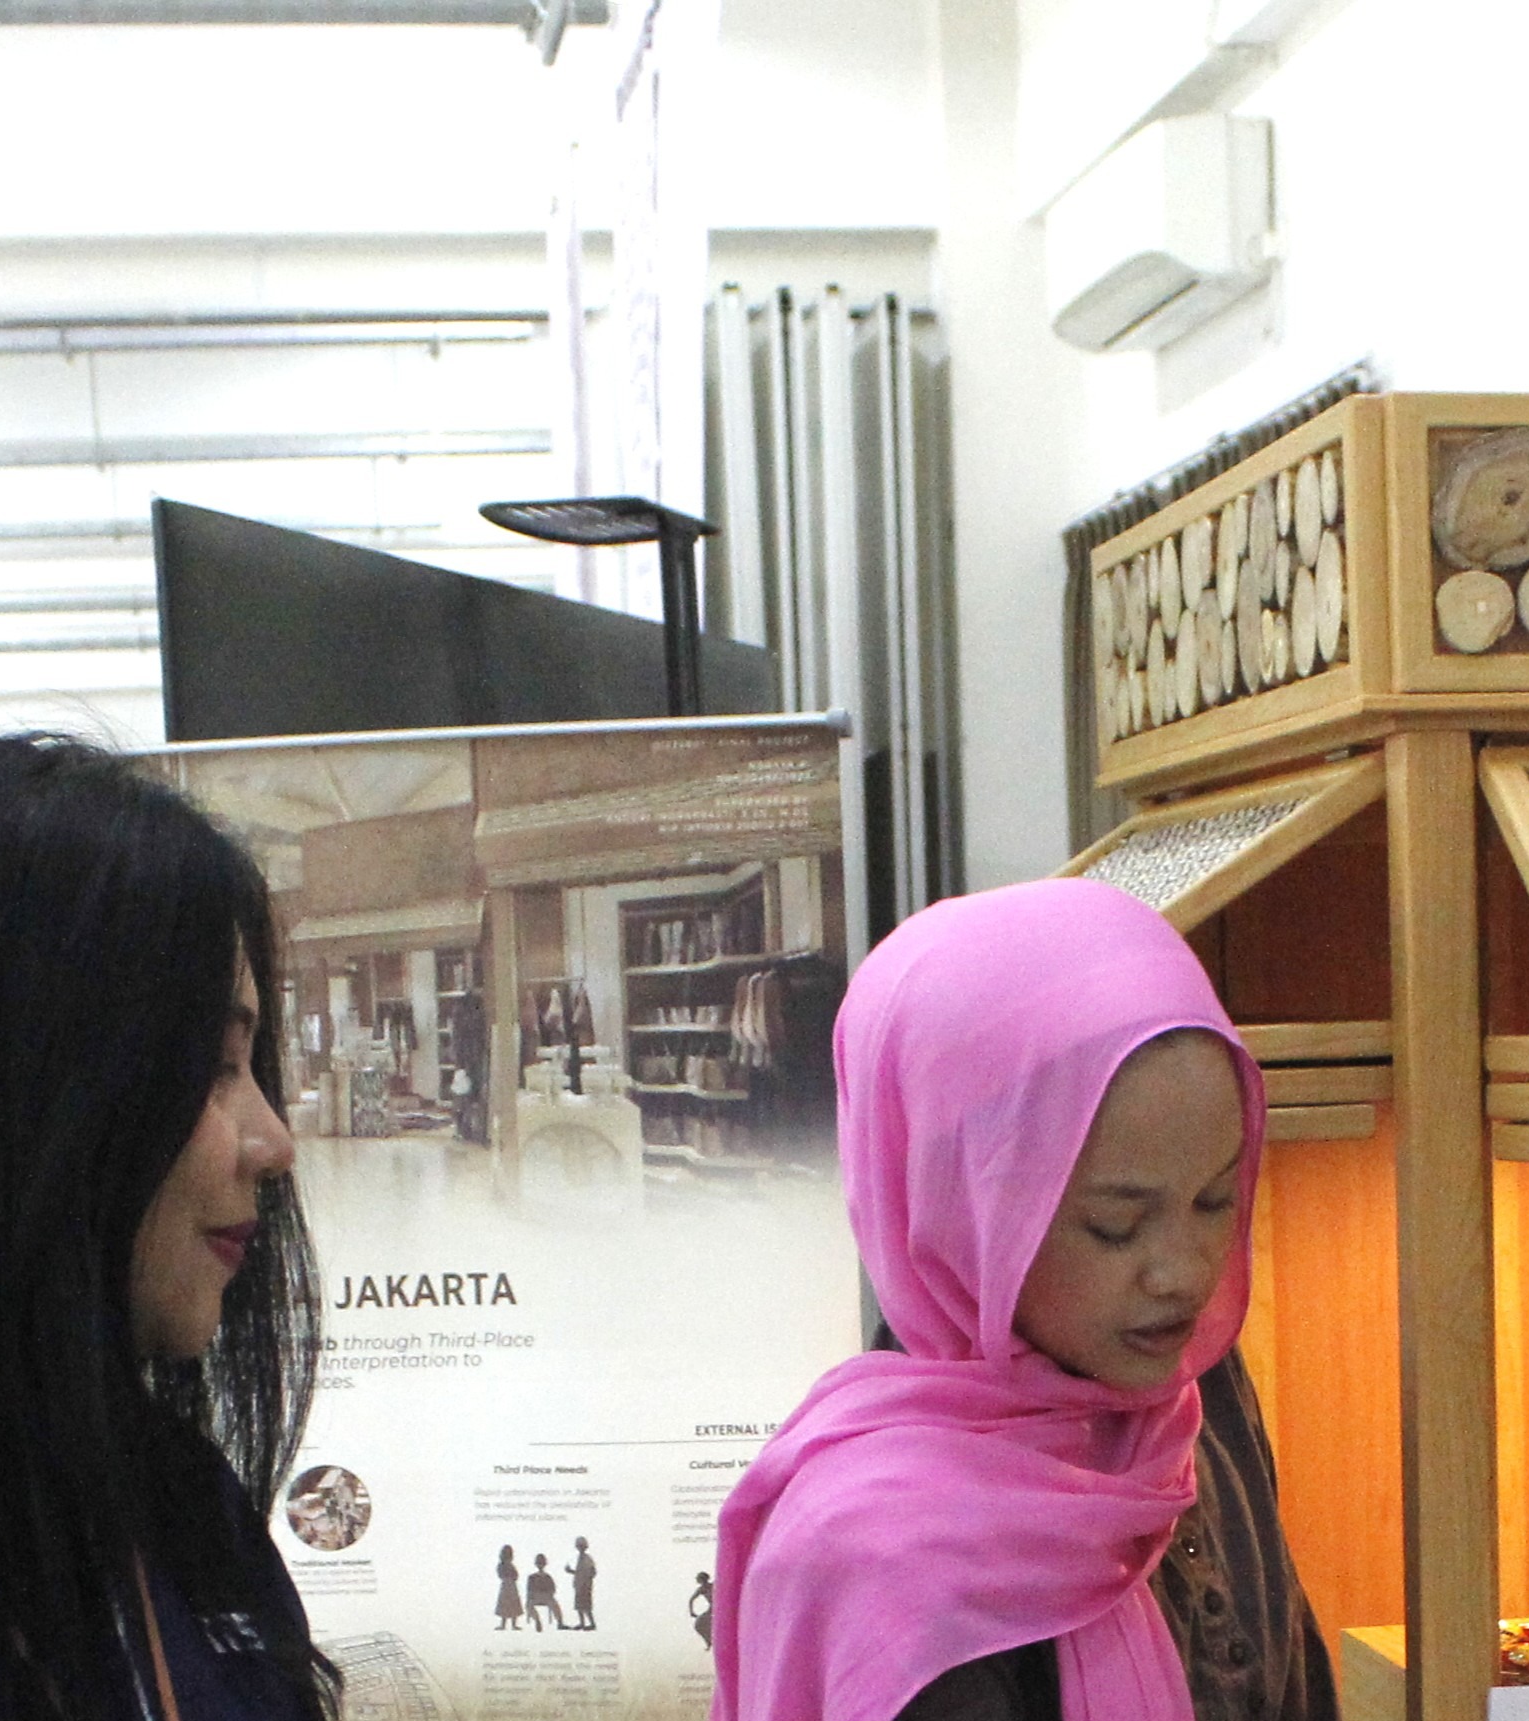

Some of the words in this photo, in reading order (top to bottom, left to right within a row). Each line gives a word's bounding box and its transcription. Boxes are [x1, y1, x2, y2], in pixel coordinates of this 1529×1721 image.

[334, 1272, 517, 1309] JAKARTA
[343, 1333, 421, 1352] through
[428, 1330, 535, 1349] Third-Place
[322, 1352, 458, 1372] Interpretation
[463, 1352, 482, 1368] to
[694, 1423, 759, 1437] EXTERNAL
[493, 1464, 520, 1475] Third
[689, 1459, 735, 1470] Cultural
